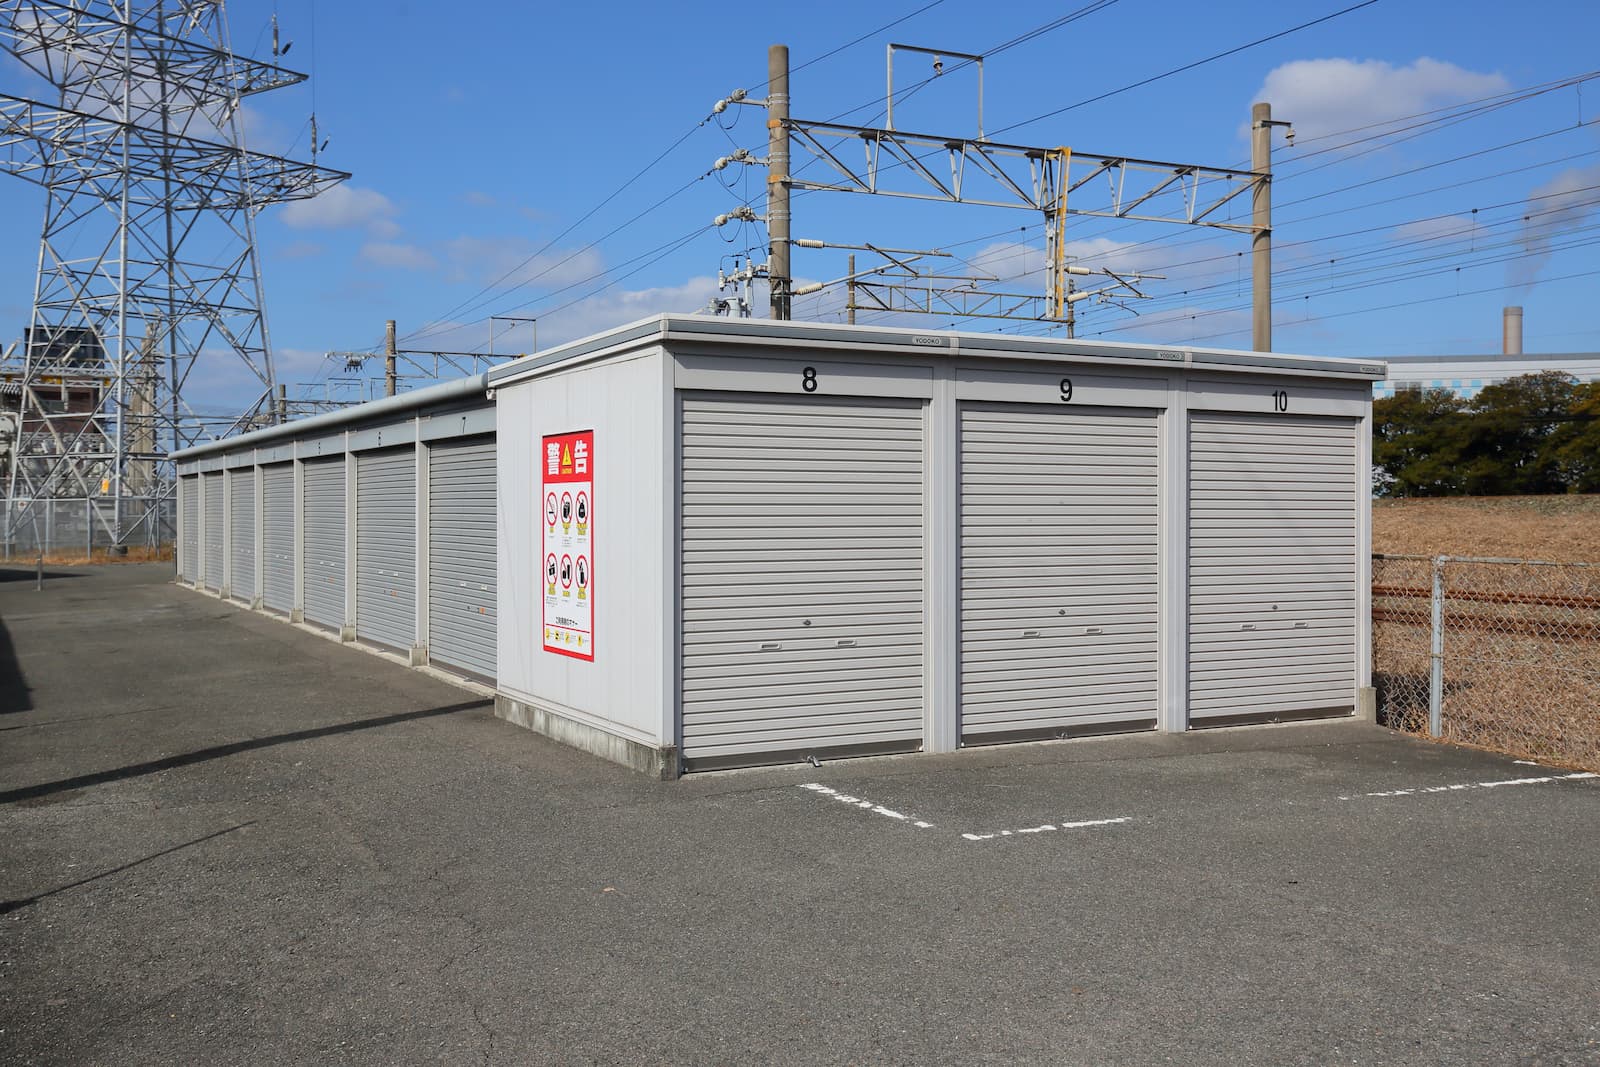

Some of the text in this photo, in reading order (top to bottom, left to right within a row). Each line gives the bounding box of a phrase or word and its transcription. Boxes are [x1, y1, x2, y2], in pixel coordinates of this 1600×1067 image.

[802, 366, 818, 393] 8
[1060, 378, 1073, 402] 9
[1272, 390, 1288, 412] 10
